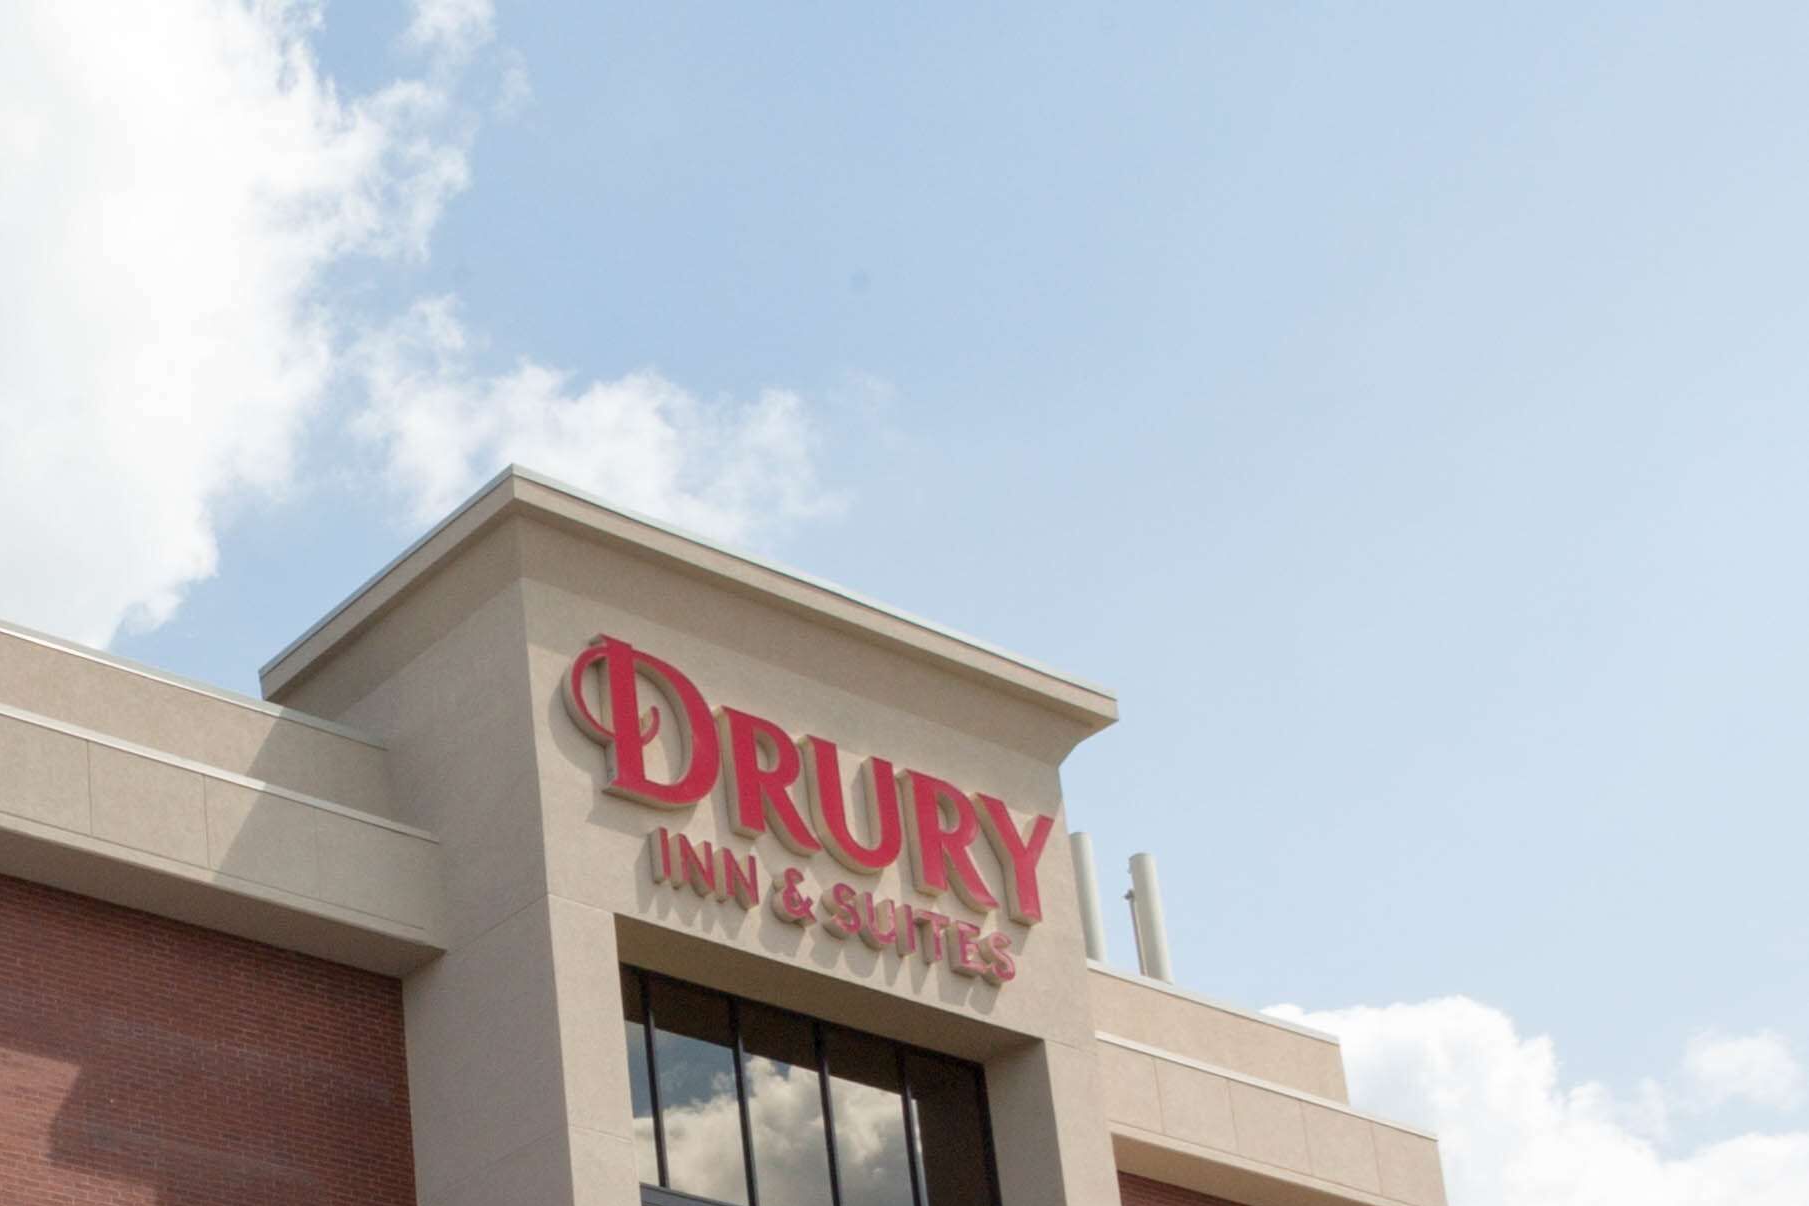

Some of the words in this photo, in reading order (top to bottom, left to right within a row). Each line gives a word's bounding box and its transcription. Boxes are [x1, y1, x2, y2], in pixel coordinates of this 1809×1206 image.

[564, 634, 1055, 927] DRURY
[651, 827, 759, 911] INN
[773, 868, 816, 927] &
[823, 882, 1016, 986] SUITES
